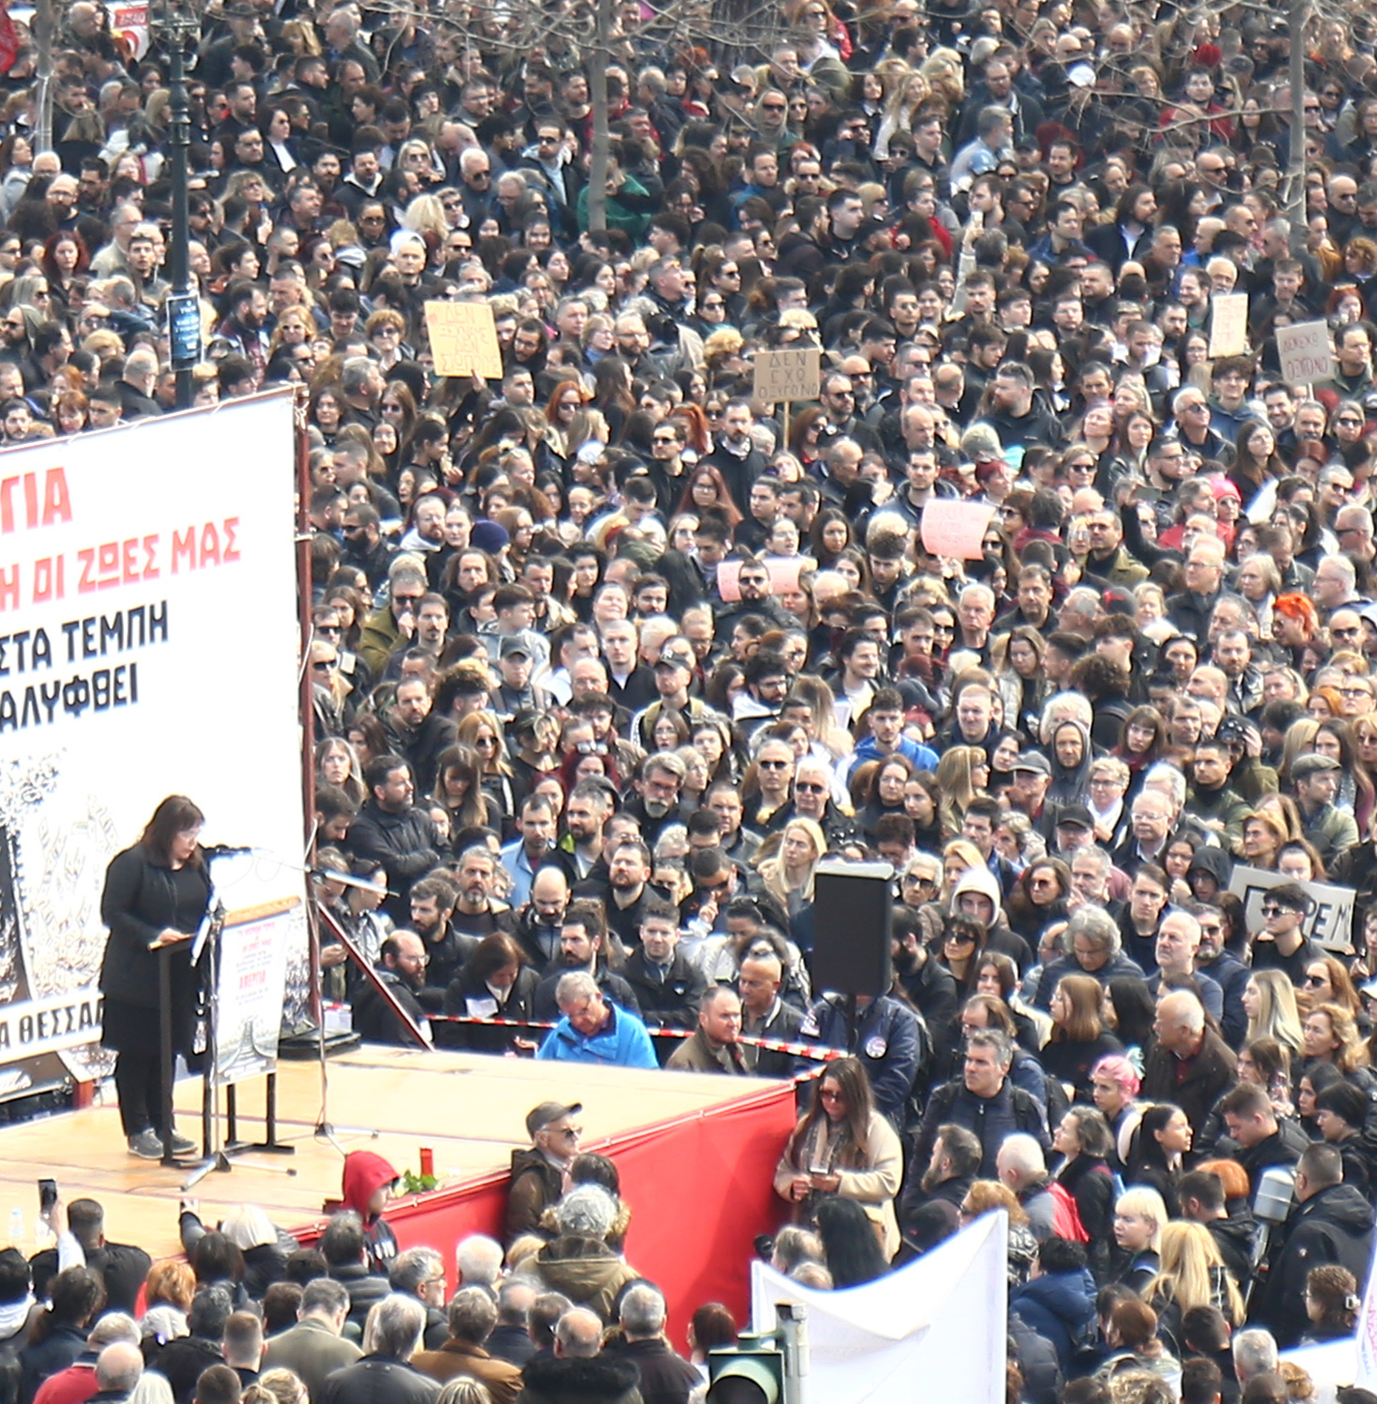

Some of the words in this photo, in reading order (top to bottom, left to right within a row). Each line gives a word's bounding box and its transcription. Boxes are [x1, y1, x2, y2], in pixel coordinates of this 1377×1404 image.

[769, 351, 807, 368] ΔΕΝ
[32, 554, 66, 604] ΟΙ
[77, 533, 162, 592] ΖΩΕΣ
[170, 515, 242, 575] ΜΑΣ
[61, 599, 169, 658] ΤΕΜΠΗ
